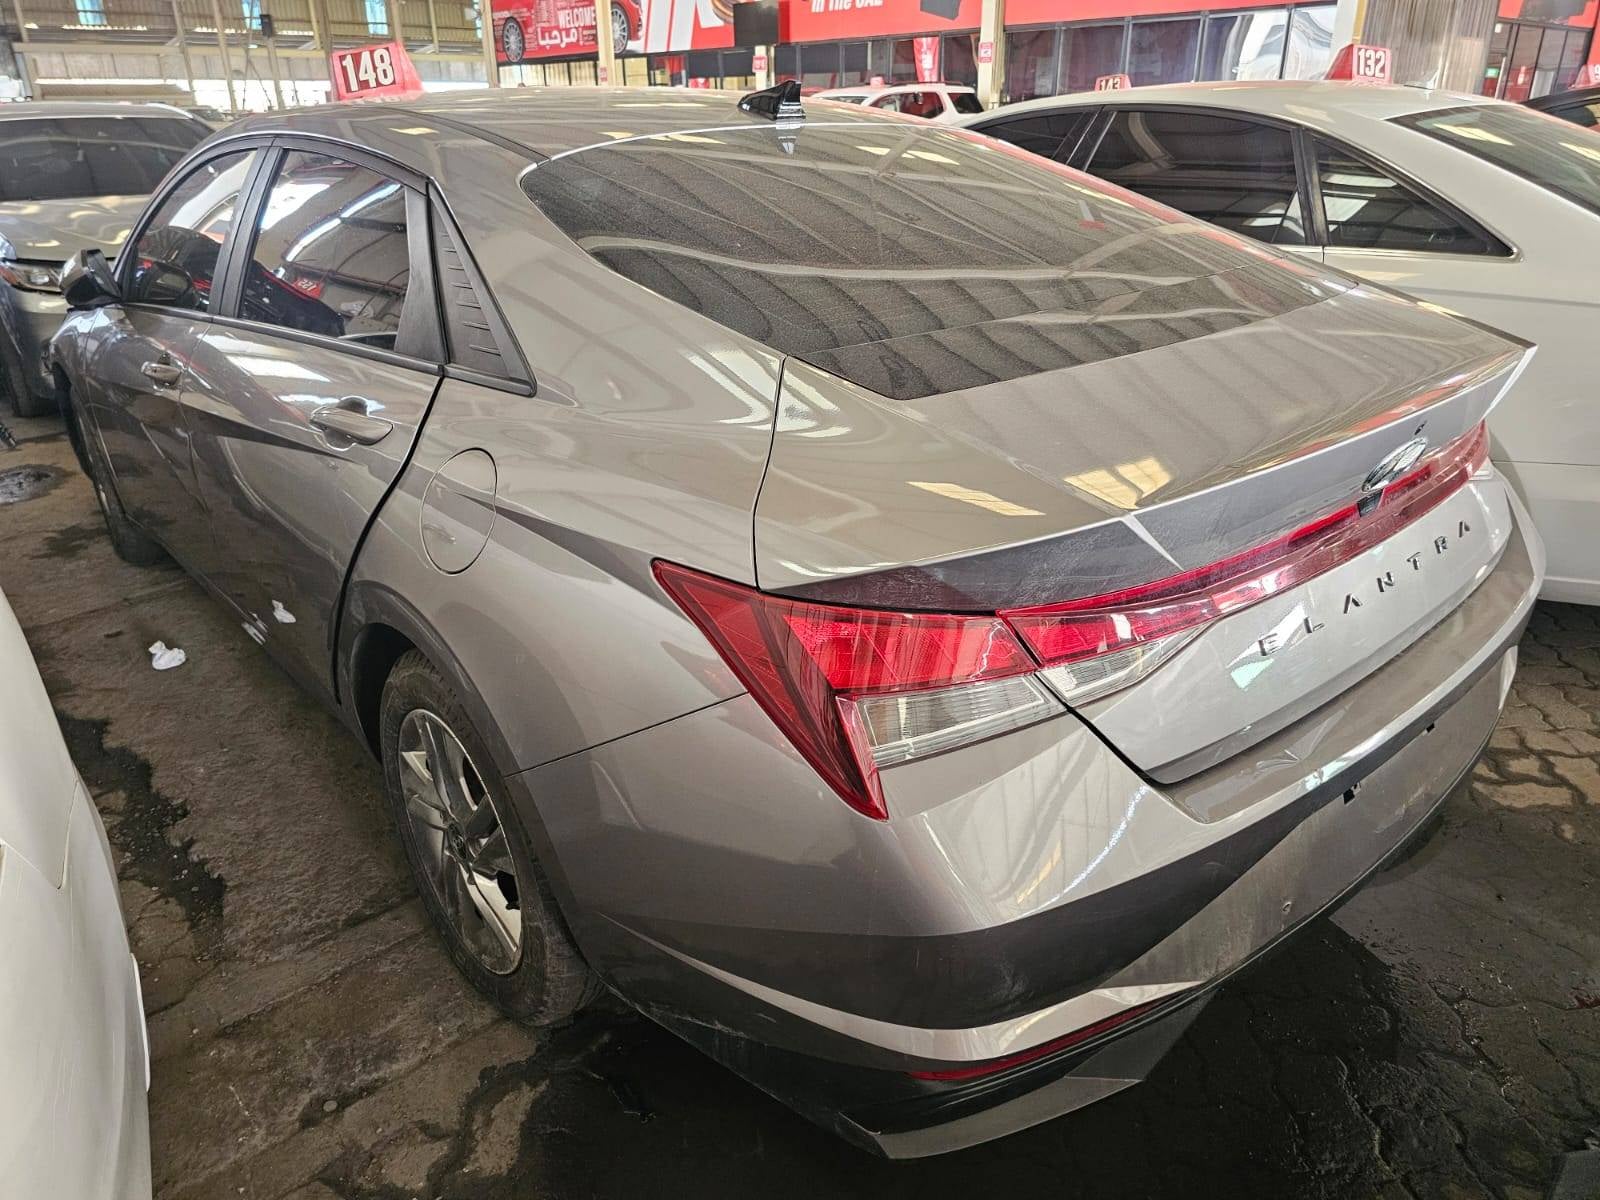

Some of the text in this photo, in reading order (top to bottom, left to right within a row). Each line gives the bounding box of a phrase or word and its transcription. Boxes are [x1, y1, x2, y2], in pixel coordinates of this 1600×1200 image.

[558, 6, 597, 29] WELCOME
[537, 27, 578, 49] مرحبا
[342, 48, 394, 92] 148
[1358, 48, 1385, 78] 132
[1258, 520, 1470, 657] ELANTRA
